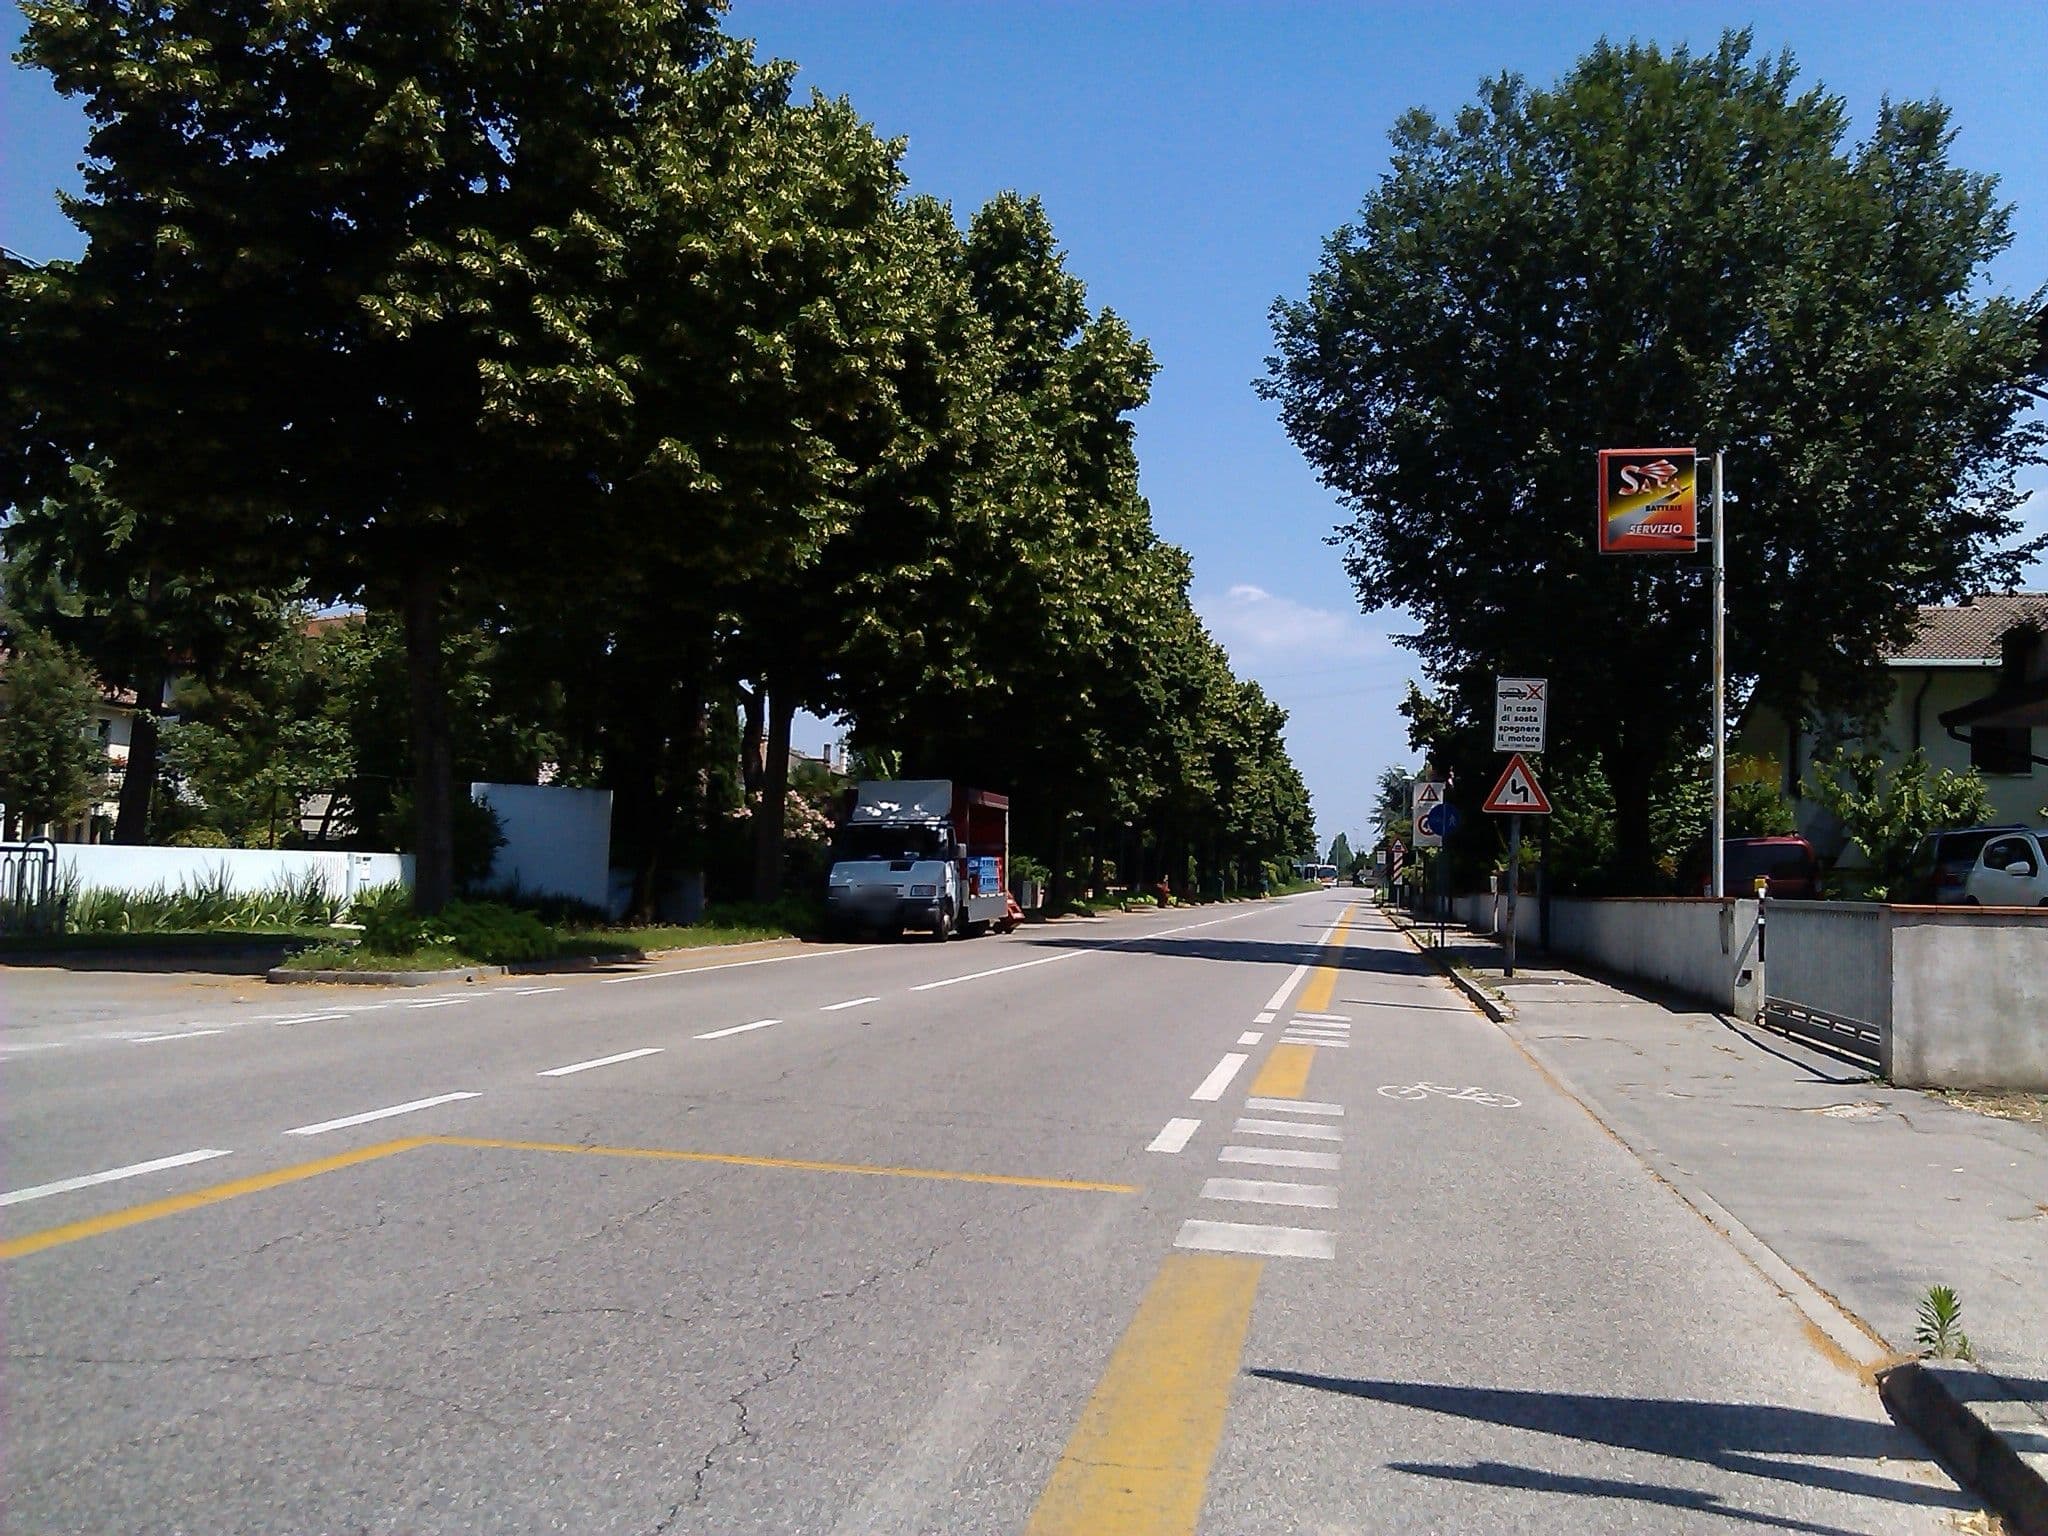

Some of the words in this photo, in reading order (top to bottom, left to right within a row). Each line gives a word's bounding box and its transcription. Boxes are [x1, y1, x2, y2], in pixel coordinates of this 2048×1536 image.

[1645, 504, 1682, 512] BATTERIE
[1630, 524, 1683, 534] SERVIZIO
[1516, 705, 1538, 713] caso
[1501, 714, 1510, 722] di
[1514, 715, 1538, 723] sosta
[1498, 725, 1541, 734] spegnere
[1508, 735, 1541, 743] motore
